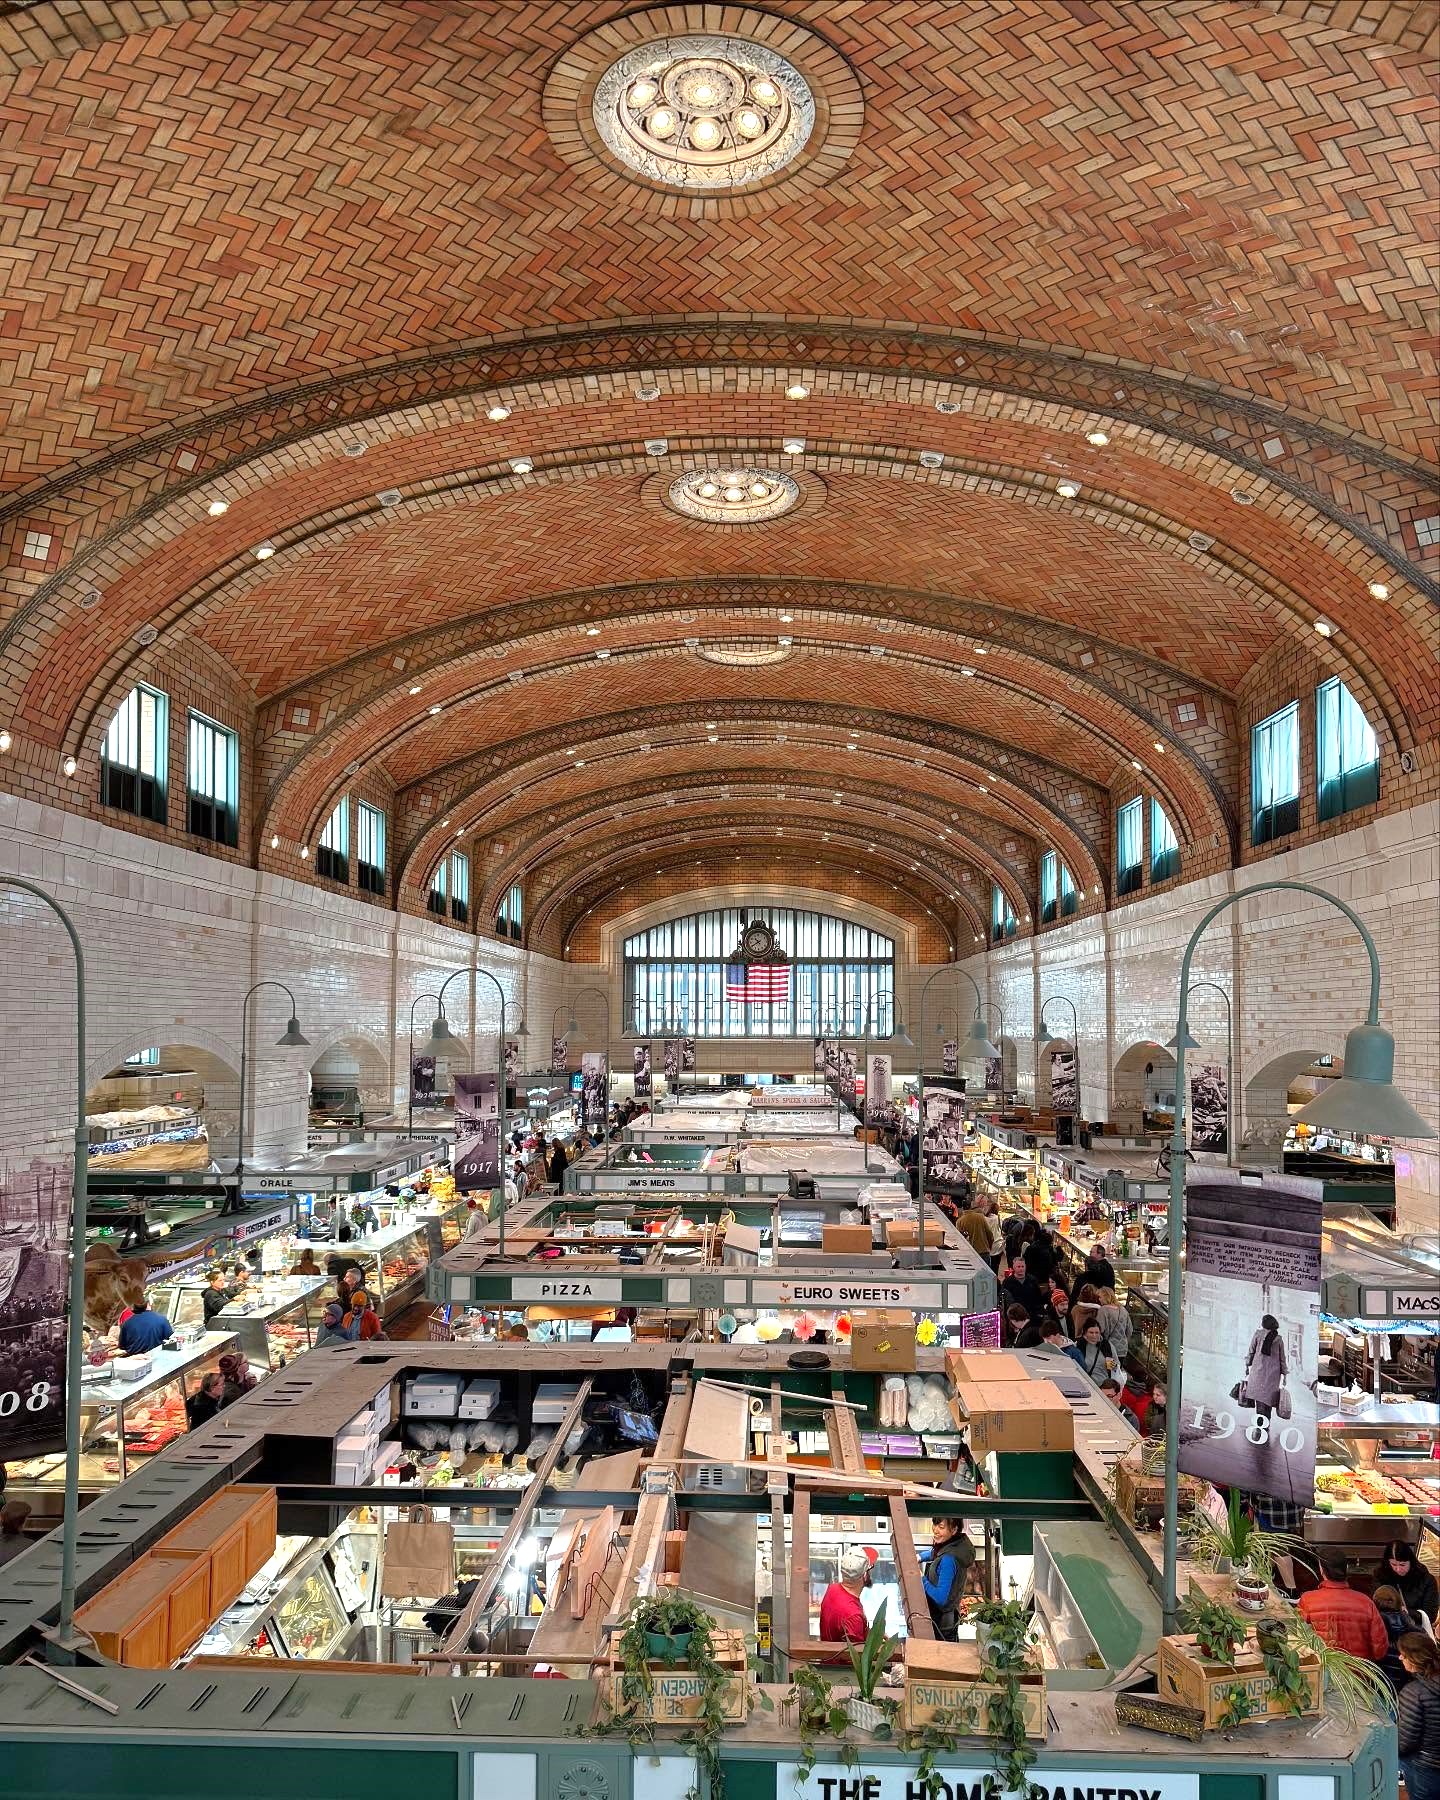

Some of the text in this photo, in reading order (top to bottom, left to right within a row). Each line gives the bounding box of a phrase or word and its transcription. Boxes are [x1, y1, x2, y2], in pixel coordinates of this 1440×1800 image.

[1195, 1130, 1222, 1142] 1977
[462, 1161, 493, 1175] 1917
[929, 1166, 958, 1180] 1977
[260, 1179, 294, 1188] ORALE
[627, 1179, 676, 1187] JIM'S MEATS
[541, 1284, 592, 1296] PIZZA
[794, 1287, 901, 1301] EURO SWEETS
[1188, 1404, 1305, 1453] 1980
[817, 1778, 882, 1800] THE
